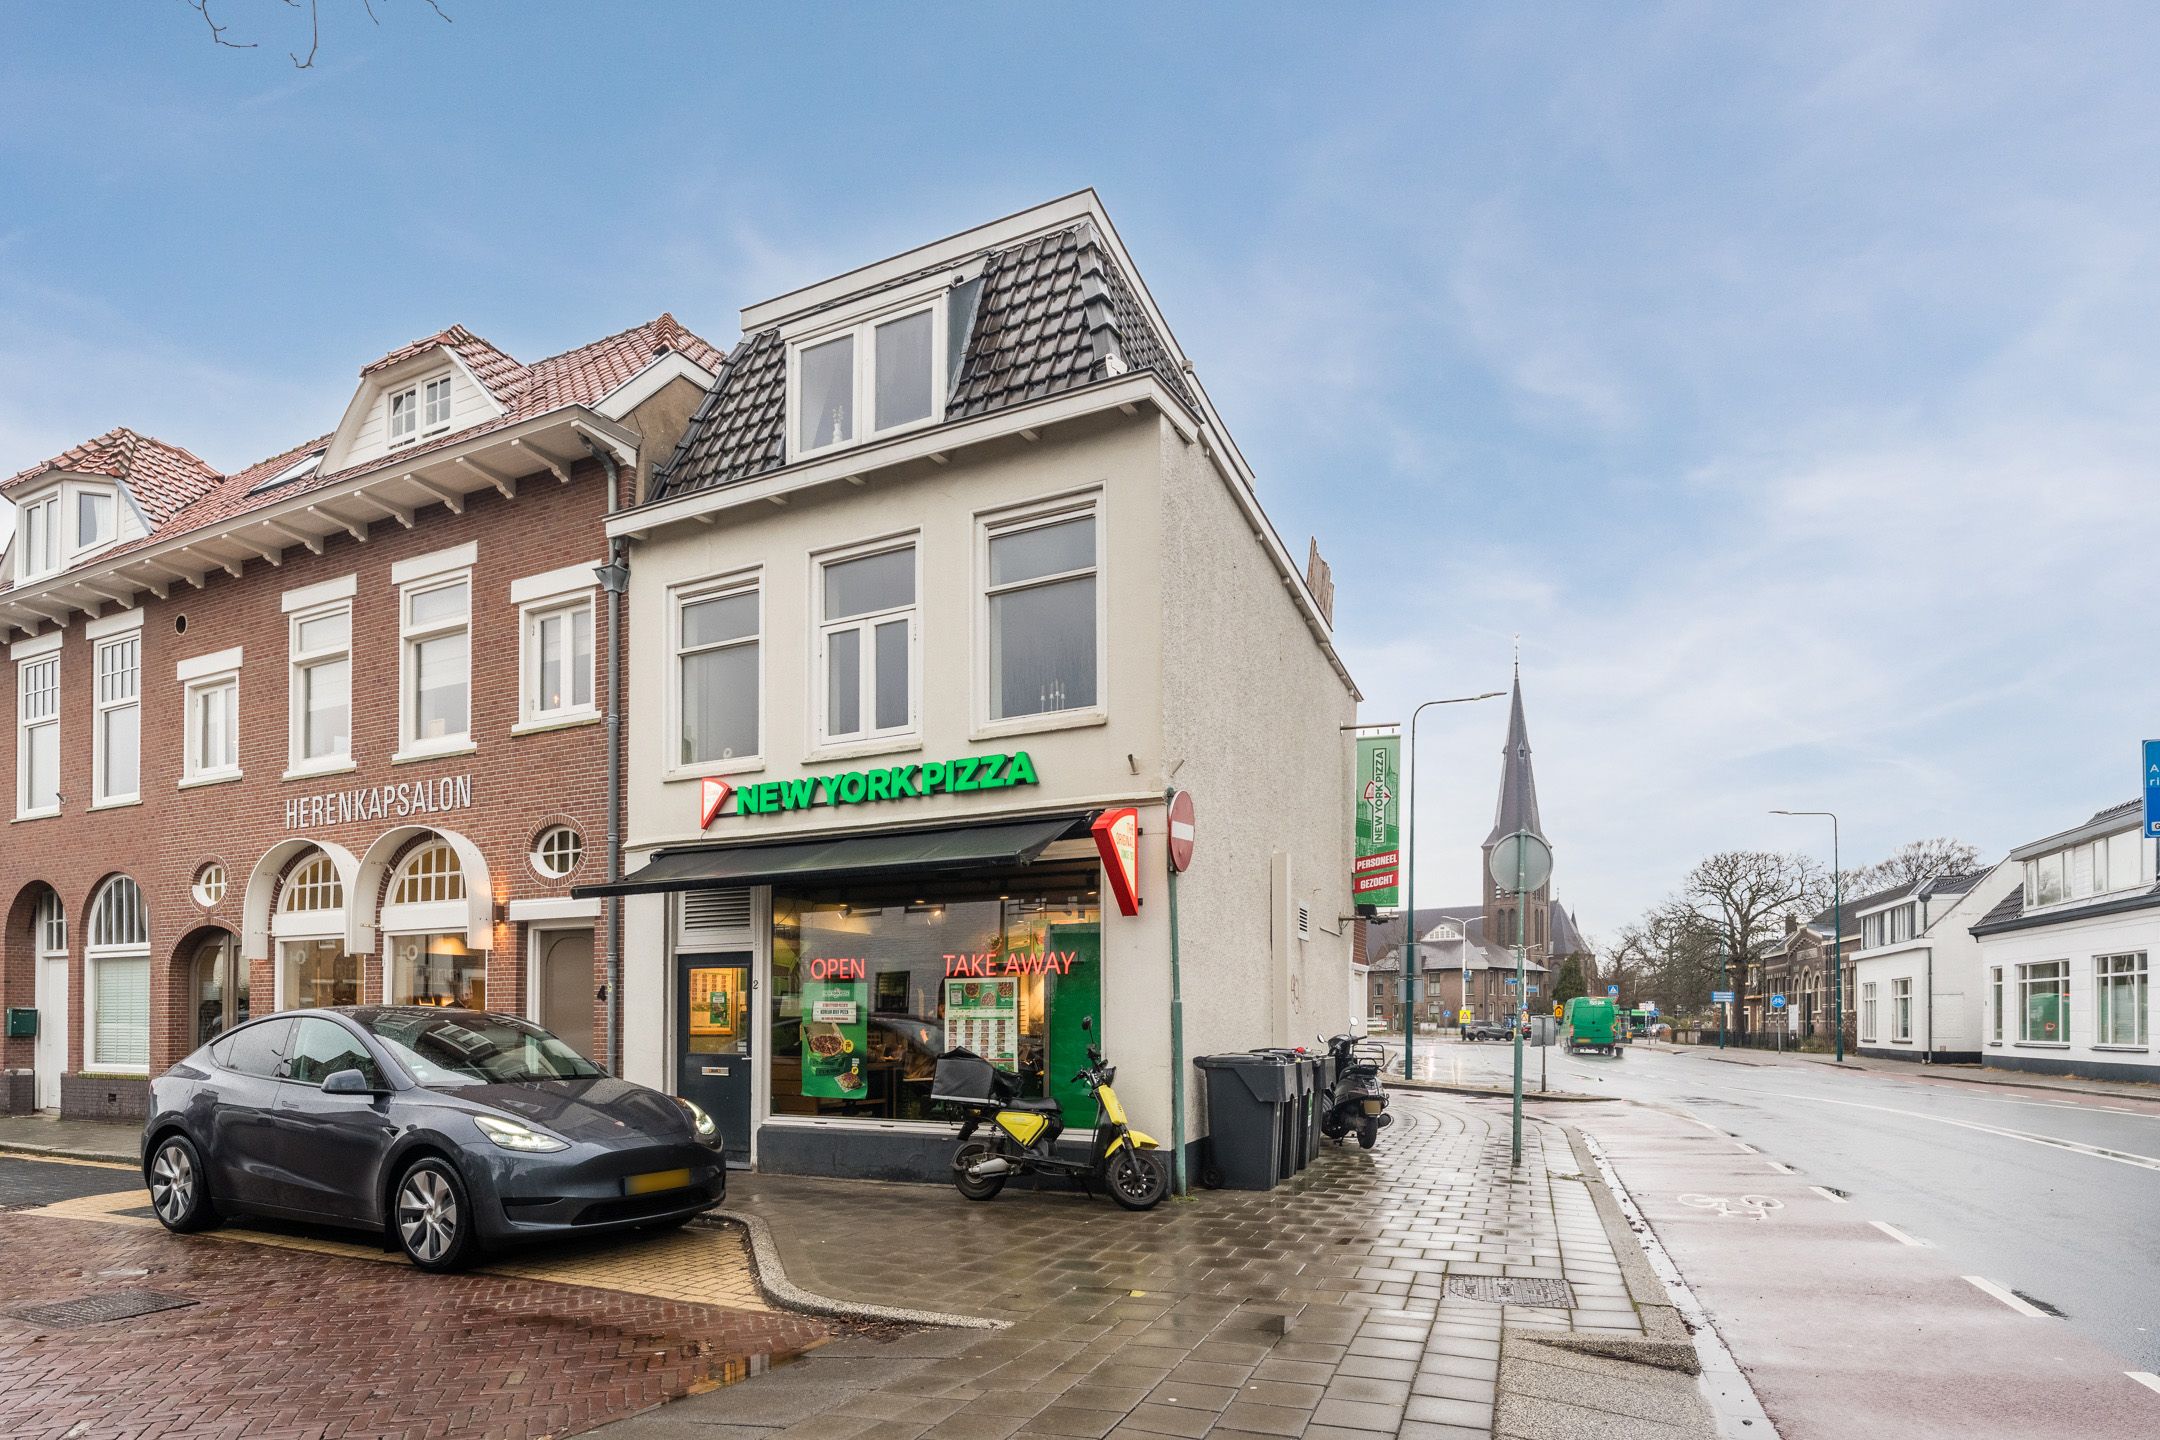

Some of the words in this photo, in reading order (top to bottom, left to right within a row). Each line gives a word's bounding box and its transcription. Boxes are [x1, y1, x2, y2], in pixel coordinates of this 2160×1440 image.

[1375, 751, 1384, 783] PIZZA
[737, 777, 816, 815] NEW
[819, 764, 920, 806] YORK
[922, 751, 1040, 796] PIZZA
[286, 774, 471, 830] HERENKAPSALON
[1374, 784, 1384, 813] YORK
[1374, 815, 1383, 841] NEW
[1357, 854, 1397, 870] PERSONEEL
[1360, 874, 1393, 890] GEZOCHT
[810, 958, 865, 979] OPEN
[942, 953, 998, 977] TAKE
[1003, 951, 1076, 976] AWAY
[753, 979, 759, 989] 2
